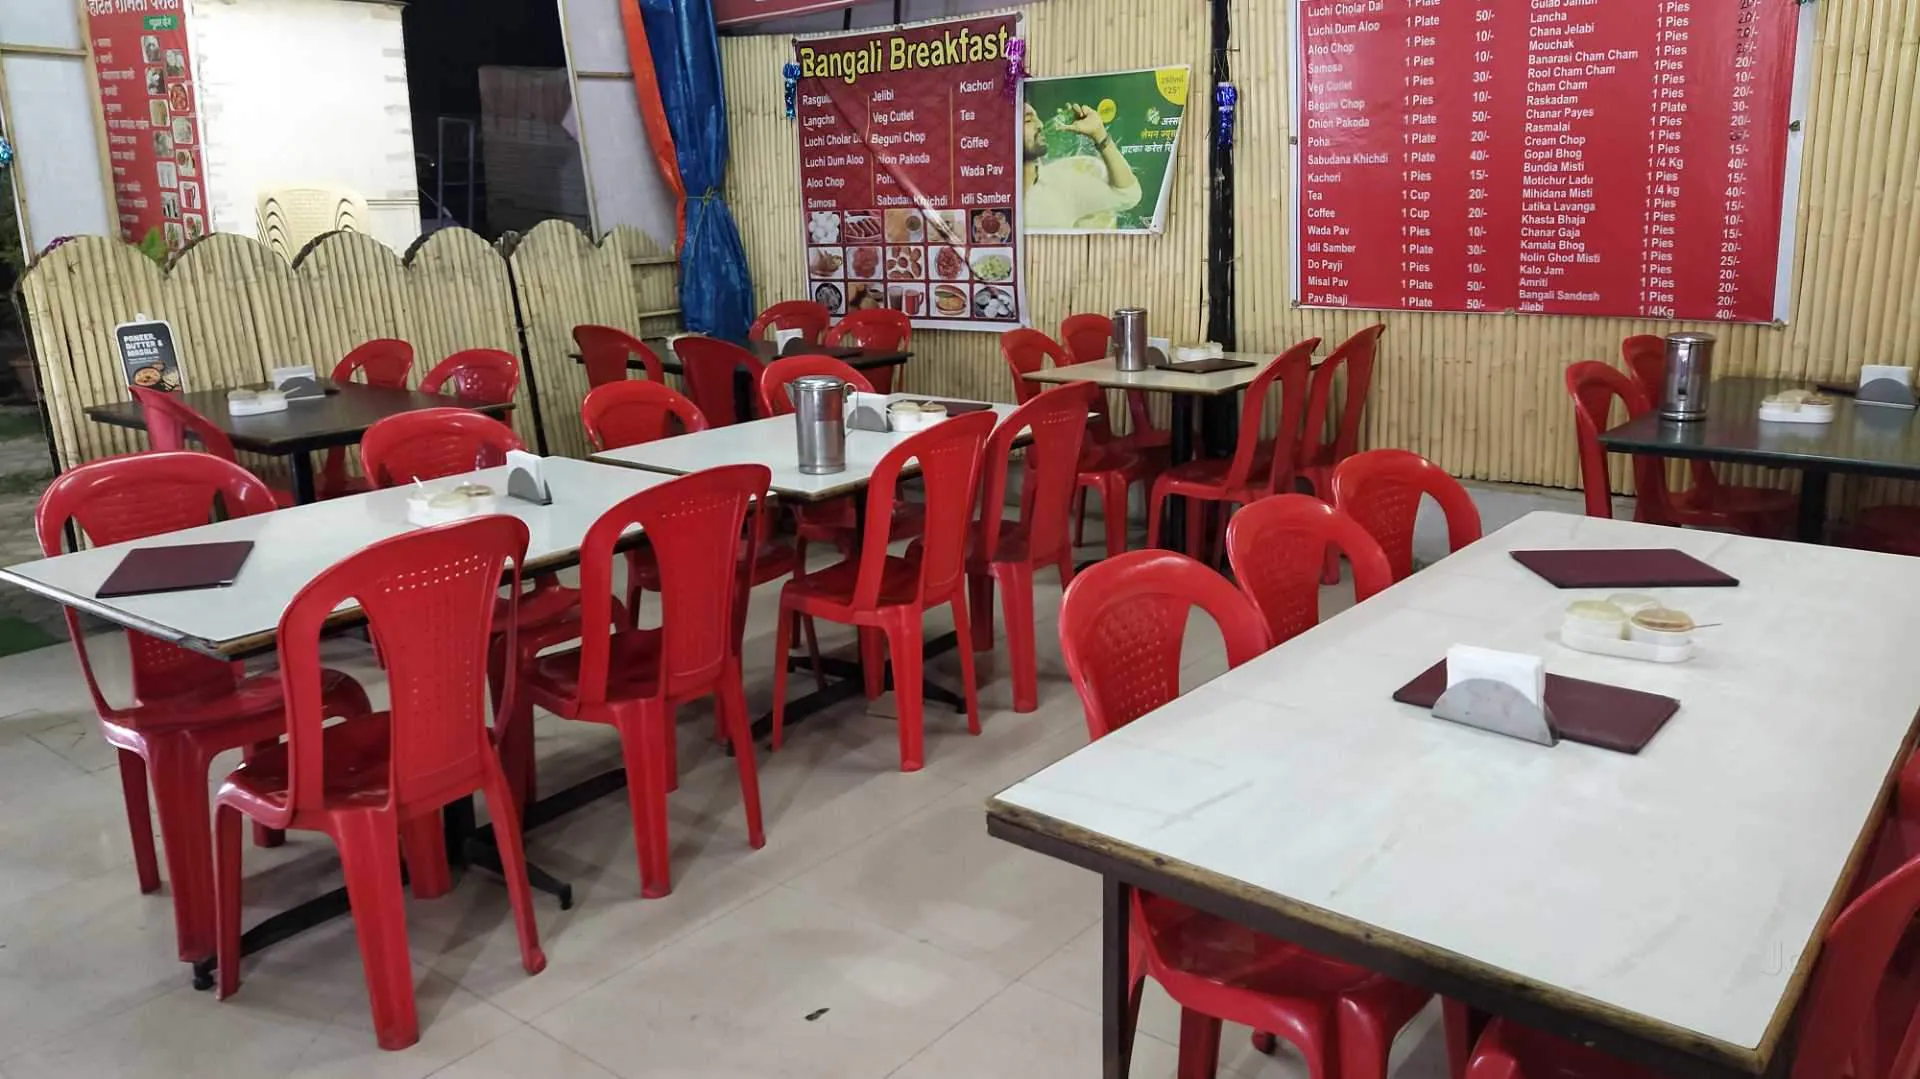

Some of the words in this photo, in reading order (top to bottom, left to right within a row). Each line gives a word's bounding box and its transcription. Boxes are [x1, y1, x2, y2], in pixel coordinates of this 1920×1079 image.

[1308, 4, 1332, 17] Luchi
[1335, 3, 1365, 16] Cholar
[1476, 9, 1495, 21] 50/-
[1531, 12, 1567, 23] Lancha
[1308, 25, 1332, 37] Luchi
[1335, 23, 1356, 34] Dum
[1358, 22, 1380, 32] Aloo
[1529, 26, 1562, 36] Chana
[1564, 24, 1594, 35] Jelabi
[1406, 37, 1410, 46] 1
[1414, 35, 1435, 45] Pies
[1476, 31, 1494, 42] 10/-
[1308, 44, 1328, 55] Aloo
[1331, 43, 1354, 54] Chop
[1529, 40, 1574, 50] Mouchak
[801, 40, 882, 85] Bangali
[890, 25, 1008, 71] Breakfast
[1529, 53, 1571, 65] Banarasi
[1575, 52, 1604, 62] Cham
[1607, 50, 1638, 60] Cham
[1736, 58, 1756, 68] 20/-
[1308, 64, 1342, 74] Samosa
[1528, 67, 1550, 78] Rool
[1553, 66, 1582, 76] Cham
[1585, 64, 1615, 75] Cham
[1473, 72, 1492, 83] 30/-
[960, 79, 994, 93] Kachori
[1308, 83, 1324, 95] Veg
[1527, 81, 1555, 92] Cham
[1559, 80, 1587, 90] Cham
[1308, 101, 1338, 113] Beguni
[1340, 99, 1365, 110] Chop
[1526, 95, 1578, 106] Raskadam
[873, 112, 888, 124] Veg
[890, 110, 914, 122] Cutlet
[961, 110, 975, 120] Tea
[1472, 111, 1491, 123] 50/-
[1526, 109, 1562, 120] Chanar
[1564, 108, 1594, 121] Payes
[803, 115, 835, 127] Langcha
[1308, 118, 1333, 128] Onion
[1336, 116, 1369, 127] Pakoda
[1731, 116, 1750, 126] 20/-
[1525, 122, 1571, 133] Rasmalai
[804, 137, 825, 147] Luchi
[827, 135, 852, 145] Cholar
[871, 133, 901, 146] Beguni
[903, 132, 925, 144] Chop
[1308, 137, 1330, 147] Poha
[1404, 134, 1408, 144] 1
[1411, 133, 1436, 144] Plate
[1471, 131, 1490, 142] 20/-
[1525, 136, 1556, 146] Cream
[1559, 136, 1585, 148] Chop
[961, 137, 989, 149] Coffee
[1524, 150, 1552, 160] Gopal
[1555, 149, 1582, 160] Bhog
[1729, 144, 1748, 154] 15/-
[806, 156, 826, 167] Luchi
[828, 155, 844, 166] Dum
[846, 155, 864, 165] Aloo
[900, 153, 930, 164] Pakoda
[1308, 154, 1350, 165] Sabudana
[1354, 153, 1388, 164] Khichdi
[1470, 151, 1489, 161] 40/-
[1524, 162, 1557, 172] Bundia
[1560, 162, 1584, 171] Misti
[1728, 159, 1747, 169] 40/-
[961, 165, 984, 176] Wada
[987, 164, 1004, 176] Pav
[1470, 170, 1488, 180] 15/-
[807, 177, 823, 188] Aloo
[825, 177, 844, 189] Chop
[1308, 173, 1341, 183] Kachori
[1523, 175, 1566, 185] Motichur
[1569, 175, 1593, 185] Ladu
[1308, 190, 1322, 200] Tea
[1402, 190, 1406, 199] 1
[1410, 190, 1430, 201] Cup
[1522, 188, 1566, 198] Mihidana
[1569, 188, 1593, 198] Misti
[808, 198, 836, 208] Samosa
[977, 193, 1011, 205] Samber
[1522, 202, 1551, 212] Latika
[1554, 202, 1596, 213] Lavanga
[1725, 201, 1744, 211] 15/-
[1308, 208, 1335, 218] Coffee
[1402, 209, 1406, 218] 1
[1409, 208, 1430, 220] Cup
[1522, 215, 1555, 224] Khasta
[1558, 215, 1585, 226] Bhaja
[1725, 215, 1743, 225] 10/-
[1308, 225, 1331, 235] Wada
[1333, 226, 1349, 236] Pav
[1468, 226, 1486, 237] 10/-
[1521, 228, 1555, 237] Chanar
[1558, 228, 1580, 239] Gaja
[1323, 243, 1356, 254] Samber
[1467, 245, 1486, 255] 30/-
[1559, 241, 1585, 252] Bhog
[1520, 253, 1545, 262] Nolin
[1548, 253, 1573, 263] Ghod
[1576, 253, 1600, 263] Misti
[1720, 256, 1740, 266] 25/-
[1308, 260, 1319, 269] Do
[1322, 260, 1342, 273] Payji
[1520, 266, 1541, 274] Kalo
[1544, 266, 1564, 275] Jam
[1308, 276, 1330, 286] Misal
[1332, 277, 1348, 287] Pav
[1467, 282, 1485, 292] 50/-
[1519, 278, 1548, 287] Amriti
[1719, 283, 1738, 293] 20/-
[1308, 293, 1324, 303] Pav
[1326, 293, 1348, 306] Bhaji
[1519, 290, 1554, 300] Bangali
[1557, 291, 1600, 301] Sandesh
[1401, 297, 1405, 306] 1
[1409, 297, 1432, 307] Plate
[1519, 302, 1544, 312] Jilebi
[1640, 306, 1644, 315] 1
[1716, 310, 1736, 320] 40/-
[126, 341, 156, 349] BUTTER
